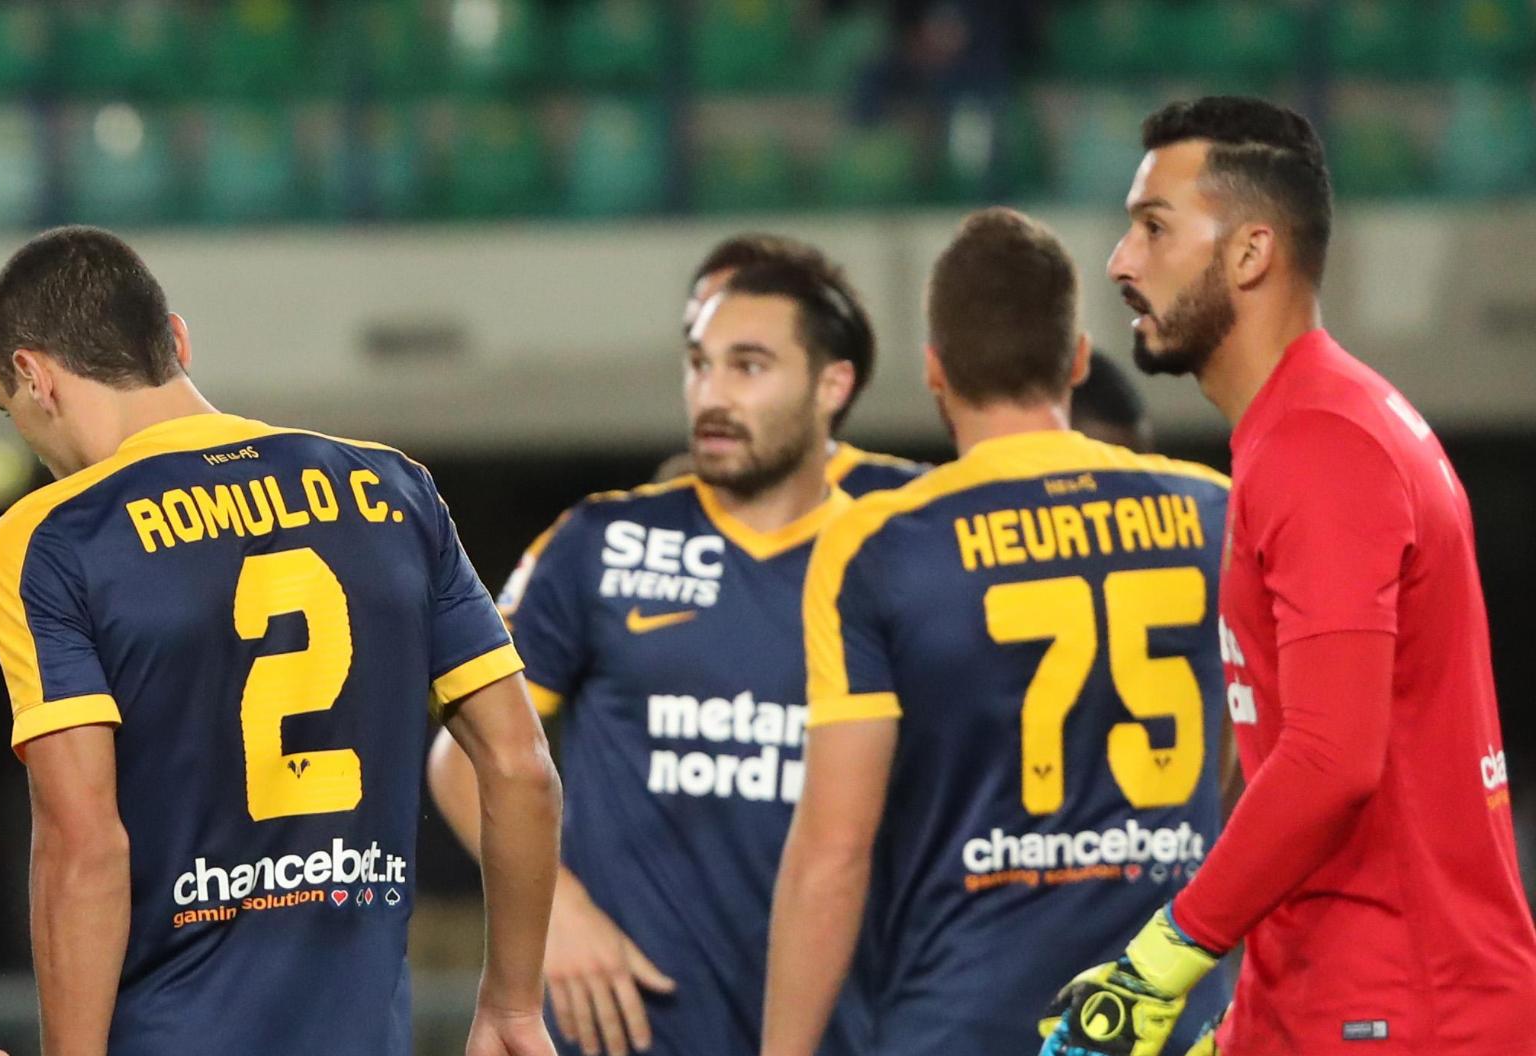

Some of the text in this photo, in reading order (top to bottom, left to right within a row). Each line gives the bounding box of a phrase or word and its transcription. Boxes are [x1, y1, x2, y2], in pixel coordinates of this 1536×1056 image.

[126, 469, 403, 553] ROMULO C.
[954, 494, 1205, 571] HEURTAUX
[601, 519, 725, 580] SEC
[599, 568, 721, 608] EVENTS
[233, 547, 363, 823] 2
[984, 566, 1207, 816] 75
[647, 744, 779, 802] nord
[173, 838, 407, 906] chancebet.it
[173, 889, 325, 928] gamin solution
